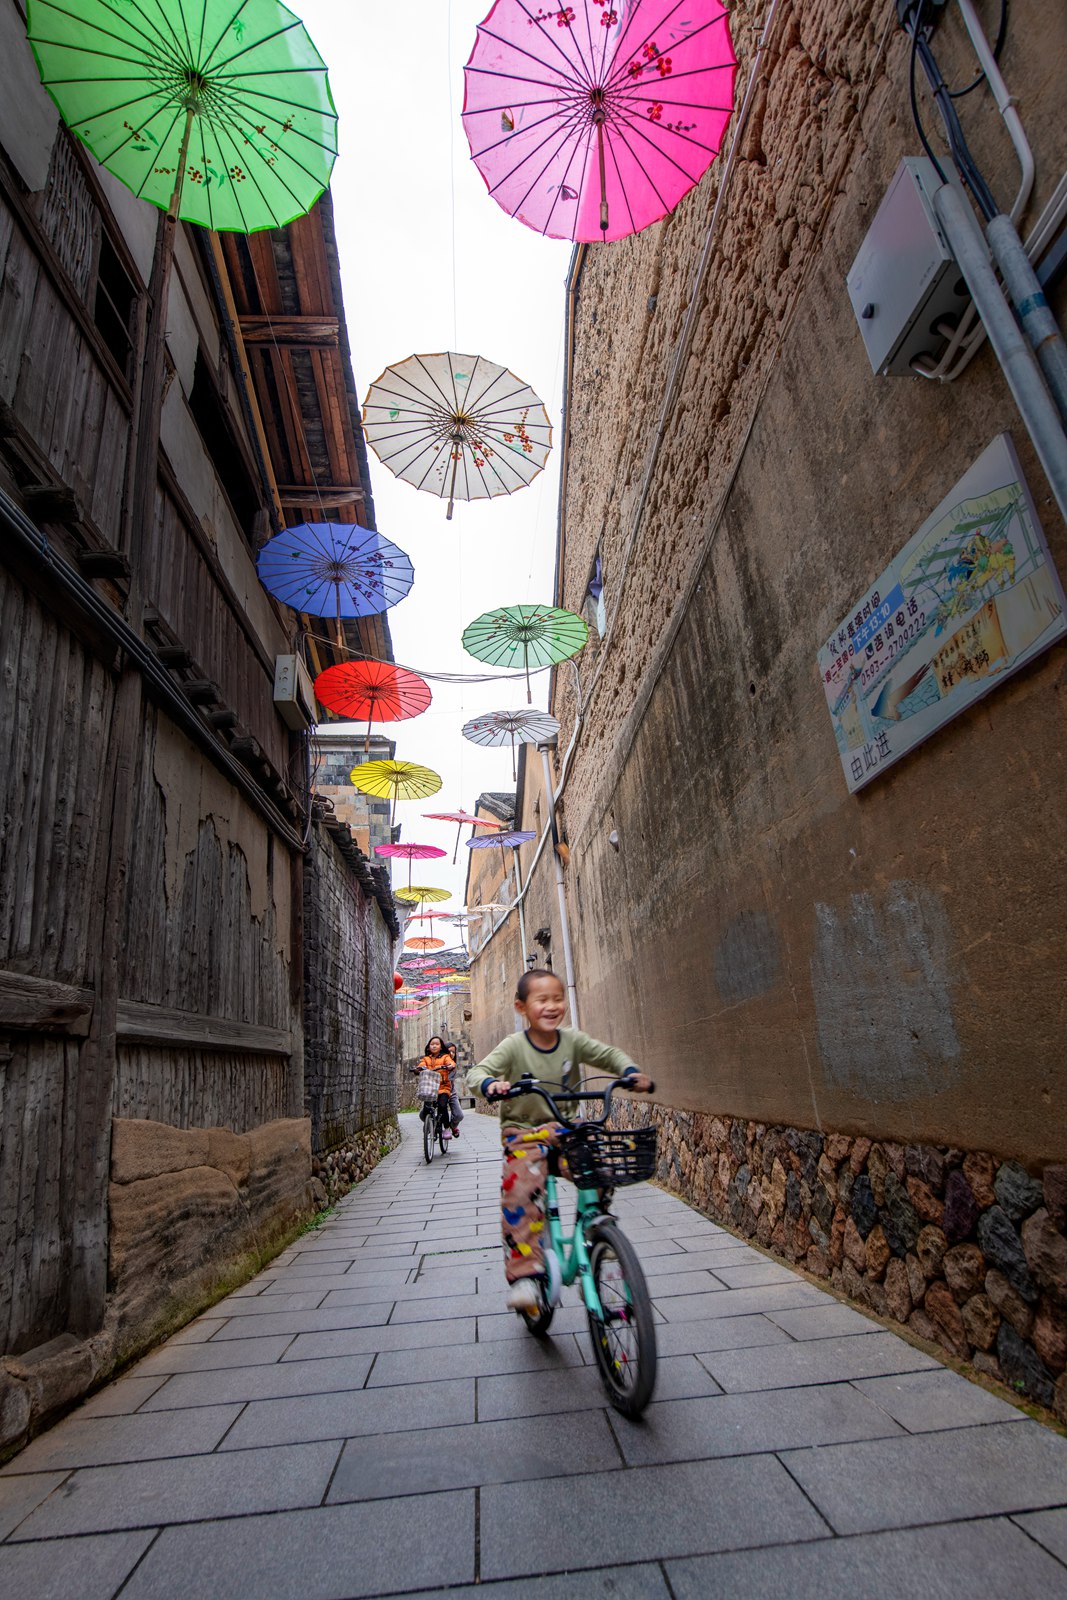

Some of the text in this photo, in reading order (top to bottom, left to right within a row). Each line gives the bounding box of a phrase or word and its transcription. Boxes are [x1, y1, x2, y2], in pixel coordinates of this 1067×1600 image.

[873, 596, 919, 652] 咨询电话
[850, 732, 892, 782] 由此进
